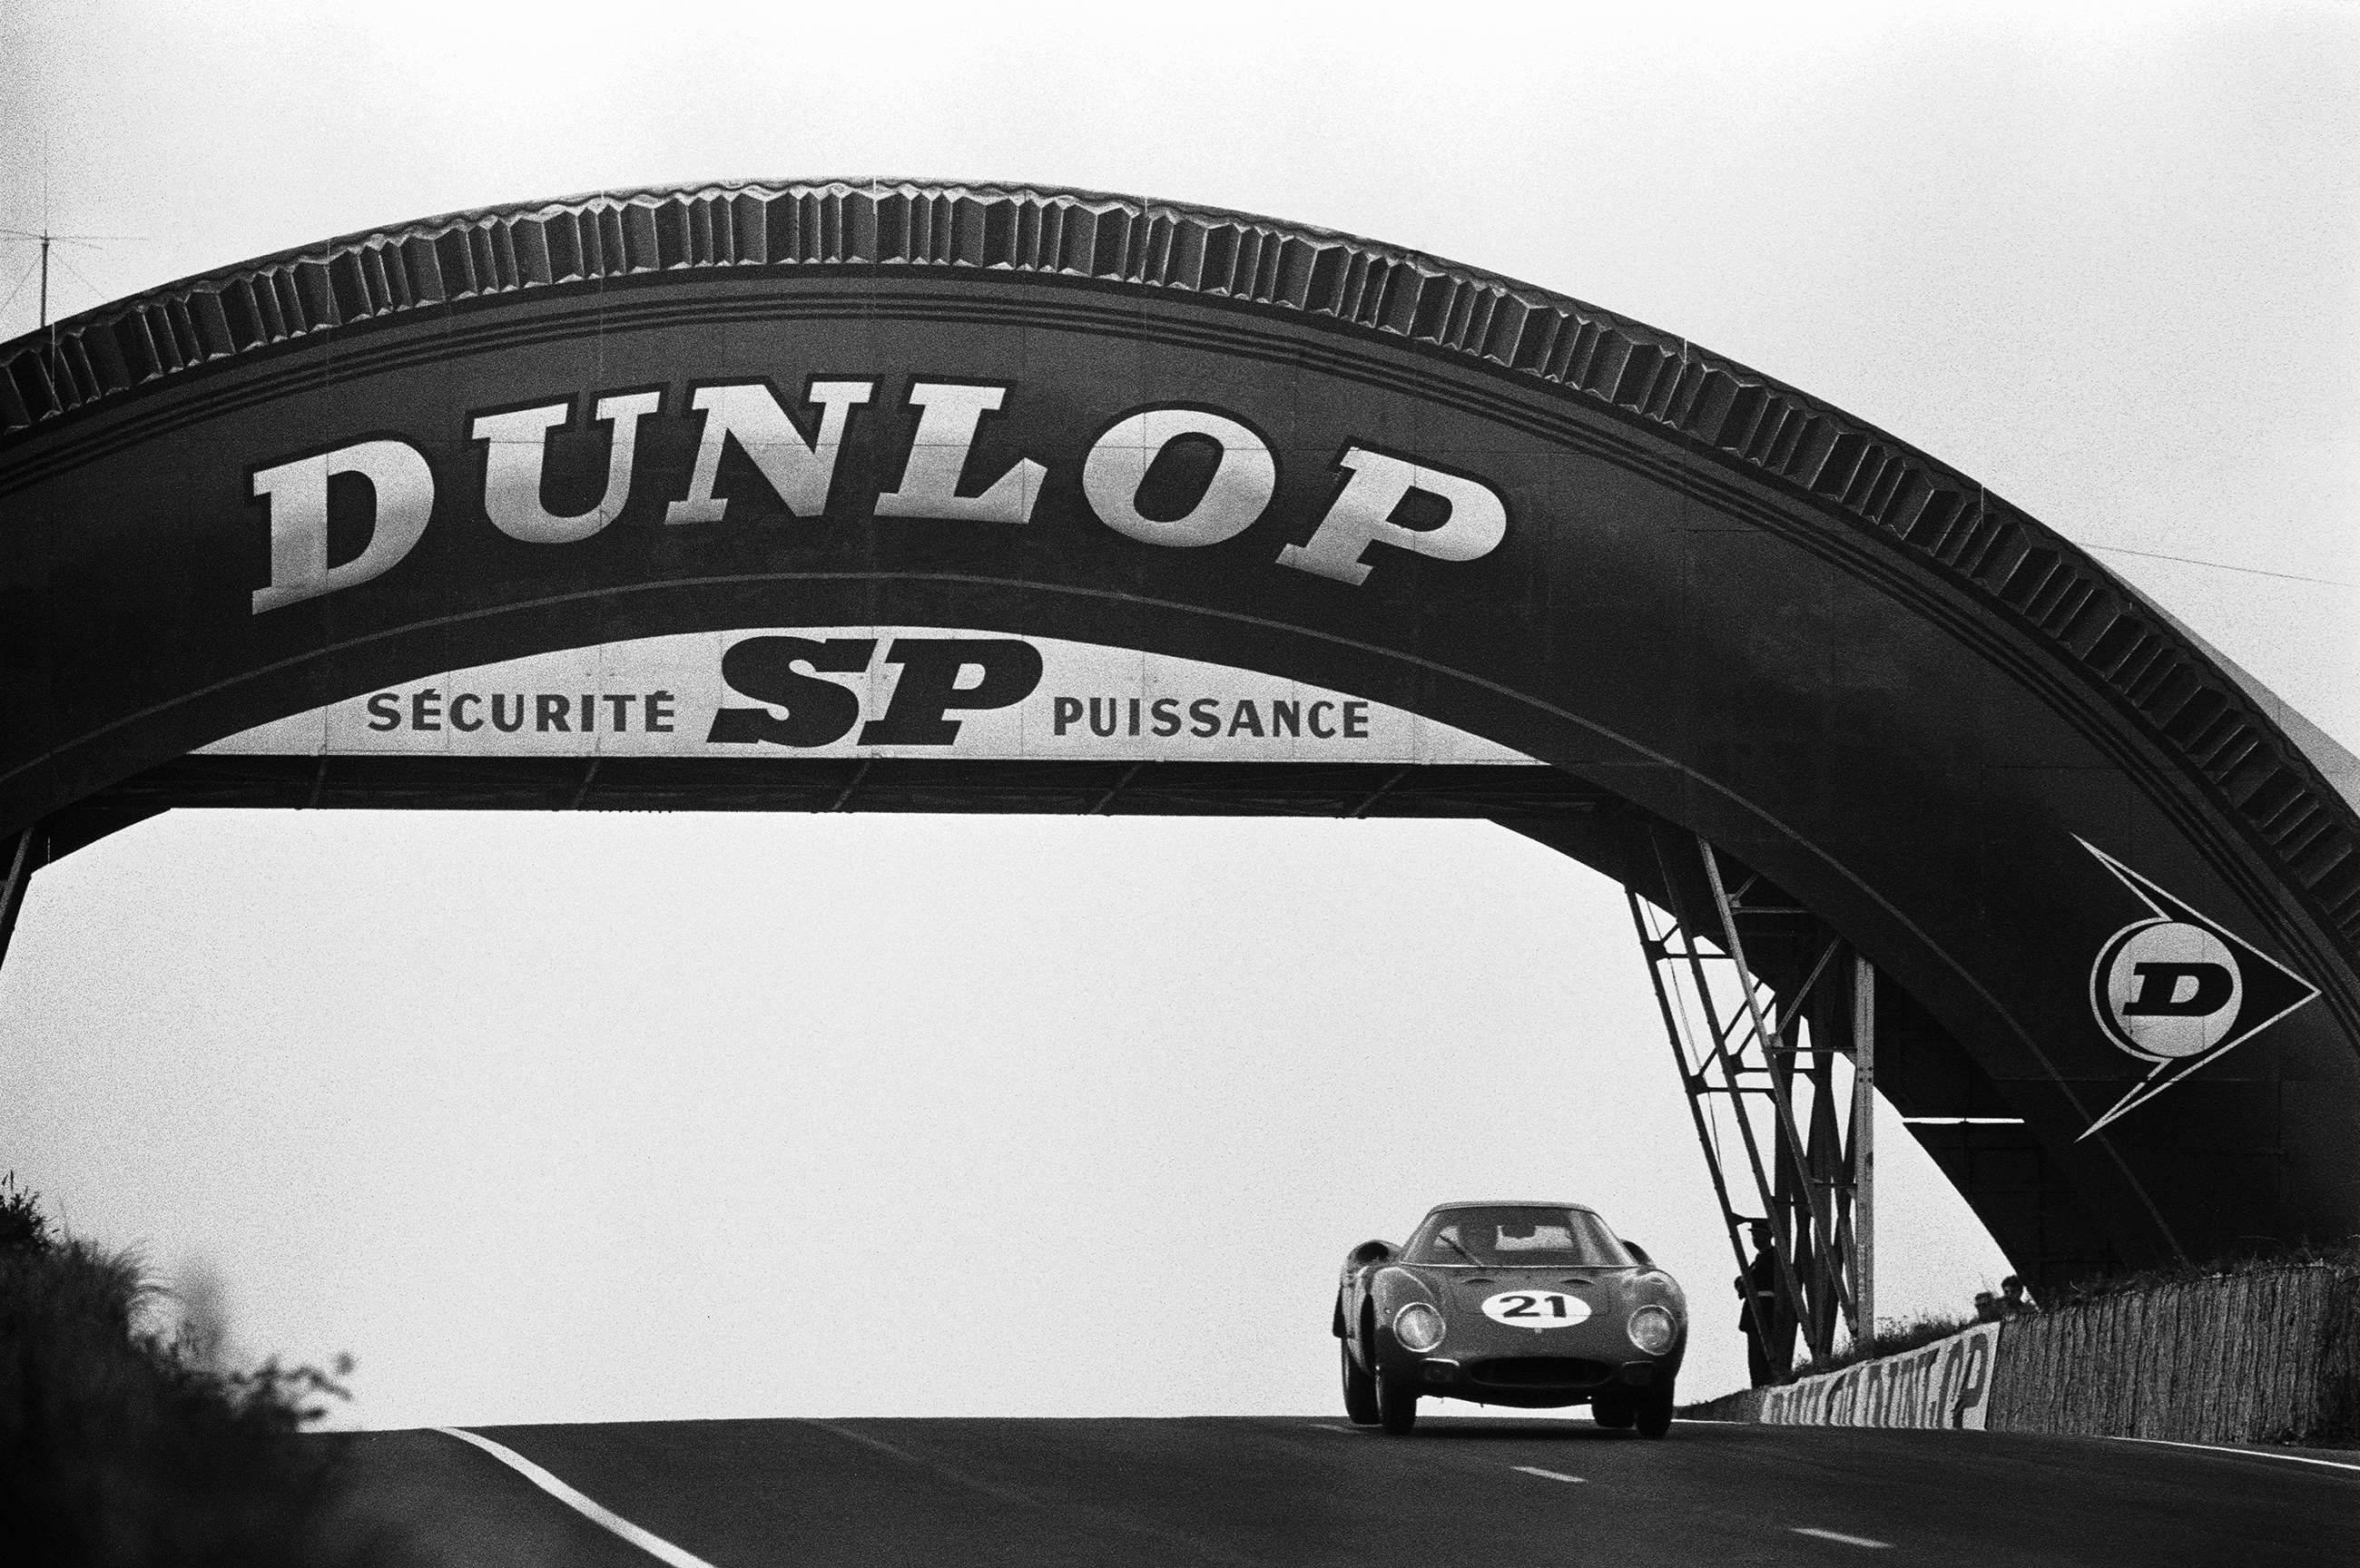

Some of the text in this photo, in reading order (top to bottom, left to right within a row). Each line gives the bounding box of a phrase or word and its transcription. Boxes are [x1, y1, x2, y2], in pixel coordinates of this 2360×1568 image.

[251, 380, 1508, 614] DUNLOP
[366, 634, 1370, 748] SÉCURITÉ SP PUISSANCE
[2121, 962, 2234, 1016] D
[1499, 1295, 1568, 1318] 21
